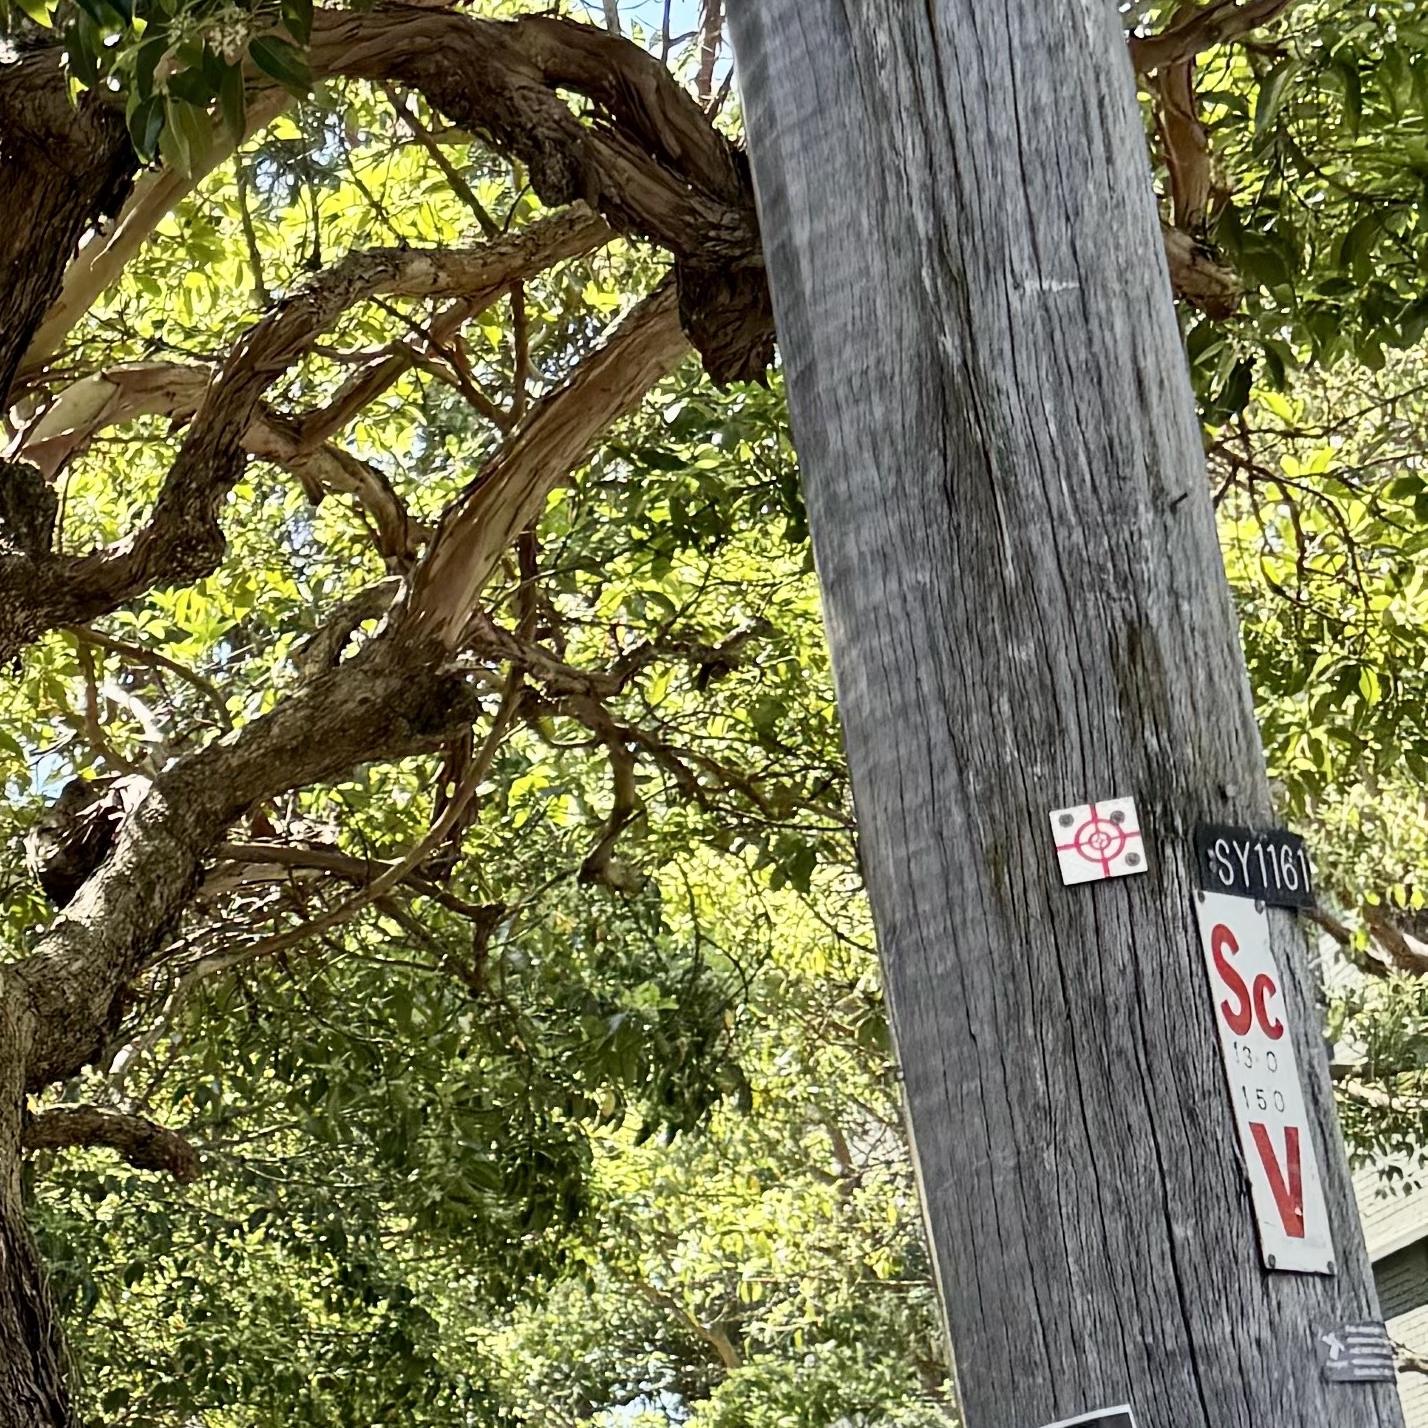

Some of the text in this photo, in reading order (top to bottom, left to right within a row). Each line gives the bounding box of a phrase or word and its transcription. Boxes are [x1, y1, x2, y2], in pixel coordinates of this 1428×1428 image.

[1215, 838, 1310, 893] SY1161
[1210, 923, 1284, 1040] Sc
[1249, 1121, 1305, 1239] V
